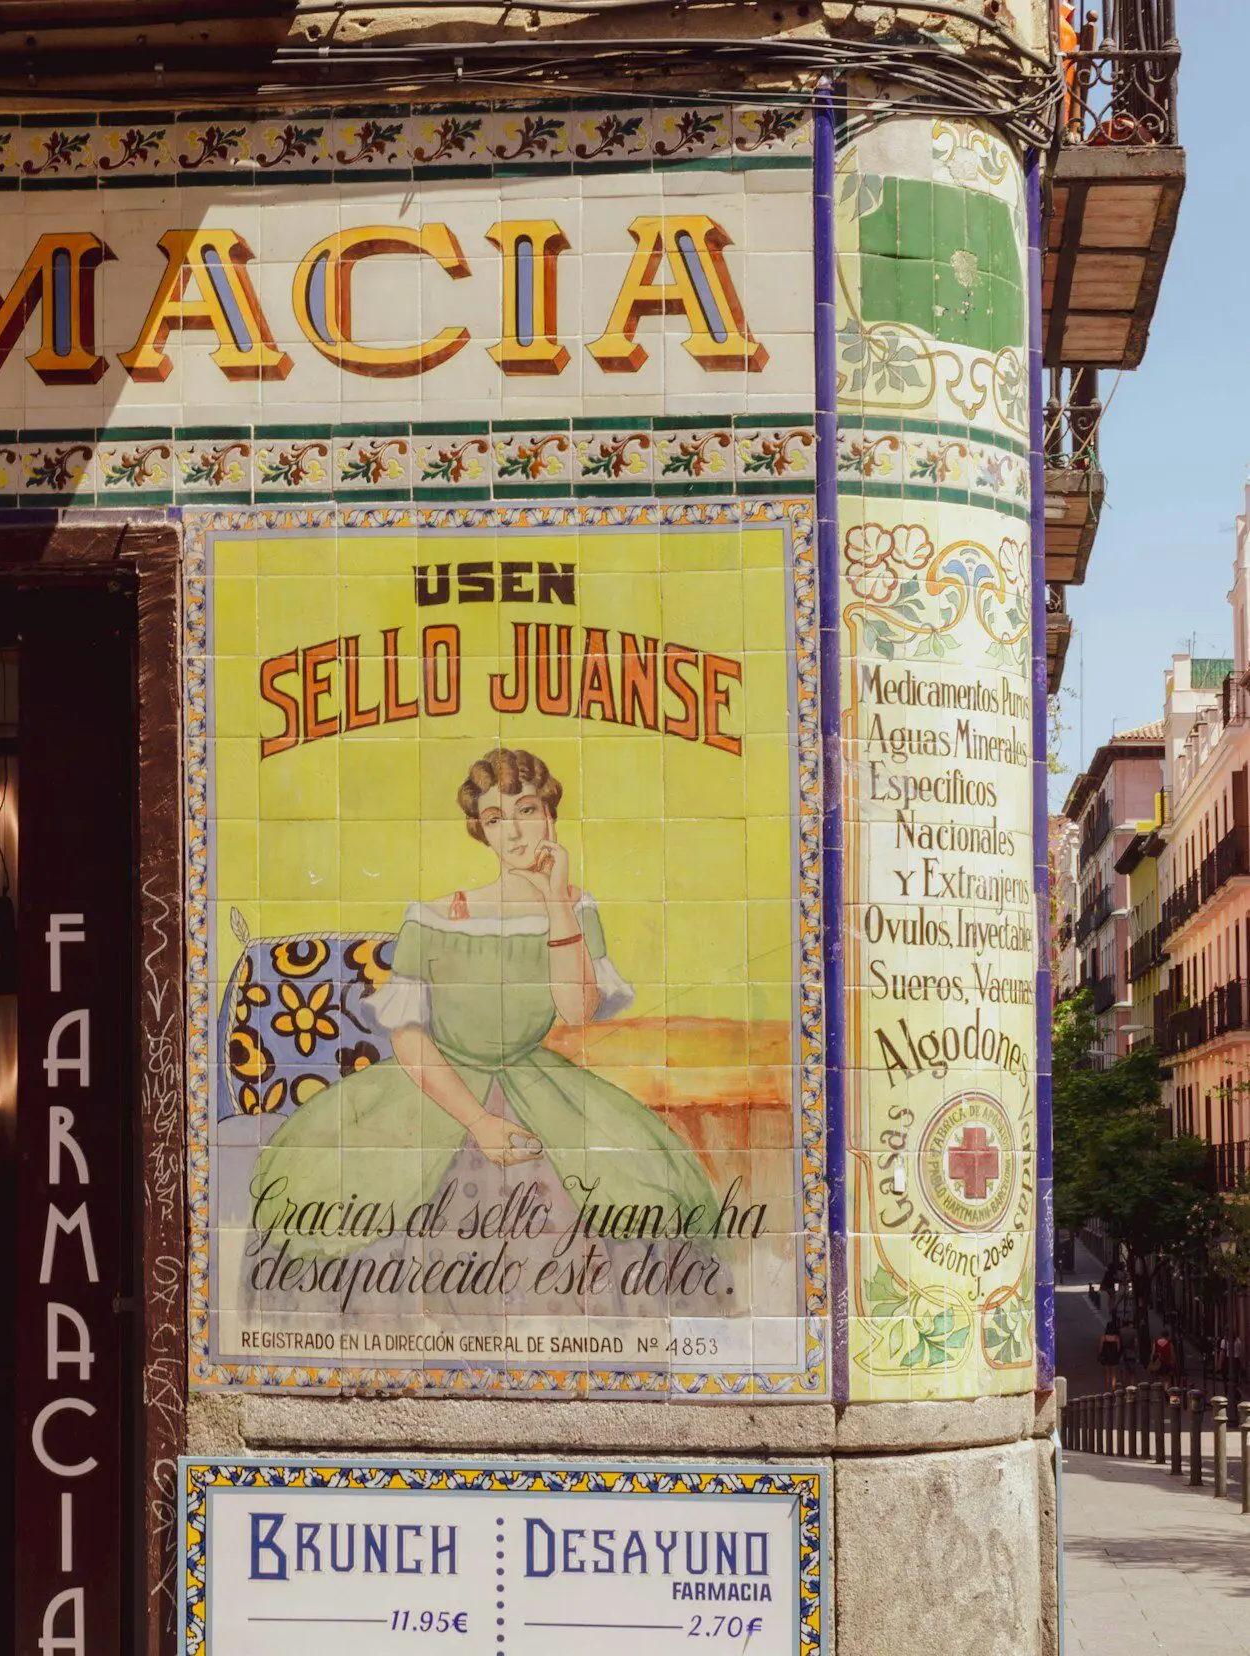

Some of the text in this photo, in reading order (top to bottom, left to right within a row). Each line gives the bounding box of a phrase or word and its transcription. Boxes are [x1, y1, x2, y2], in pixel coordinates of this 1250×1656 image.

[412, 560, 578, 607] USEN
[260, 621, 743, 762] SELLO JUANSE
[859, 664, 1030, 722] Medicamentos Puros
[864, 713, 1028, 768] Aguas Minerales
[895, 808, 1015, 857] Nacionales
[922, 857, 1030, 915] Extranjeros
[874, 1007, 1029, 1089] Algodones
[969, 1105, 980, 1117] DE
[244, 1174, 767, 1258] Gracias al sello Juanse ha
[32, 913, 99, 1656] FARMACIA
[249, 1241, 736, 1312] desaparecido este dolor.
[241, 1331, 334, 1350] REGISTRADO
[340, 1334, 358, 1350] EN
[364, 1334, 381, 1351] LA
[385, 1330, 454, 1351] DIRECCIÓN
[459, 1335, 520, 1352] GENERAL
[527, 1337, 544, 1352] DE
[550, 1337, 623, 1353] SANIDAD
[665, 1337, 719, 1356] 4853
[248, 1512, 772, 1581] BRUNCH DESAYUNO
[672, 1582, 772, 1602] FARMACIA
[390, 1610, 763, 1638] 11.95€ 2.70€
